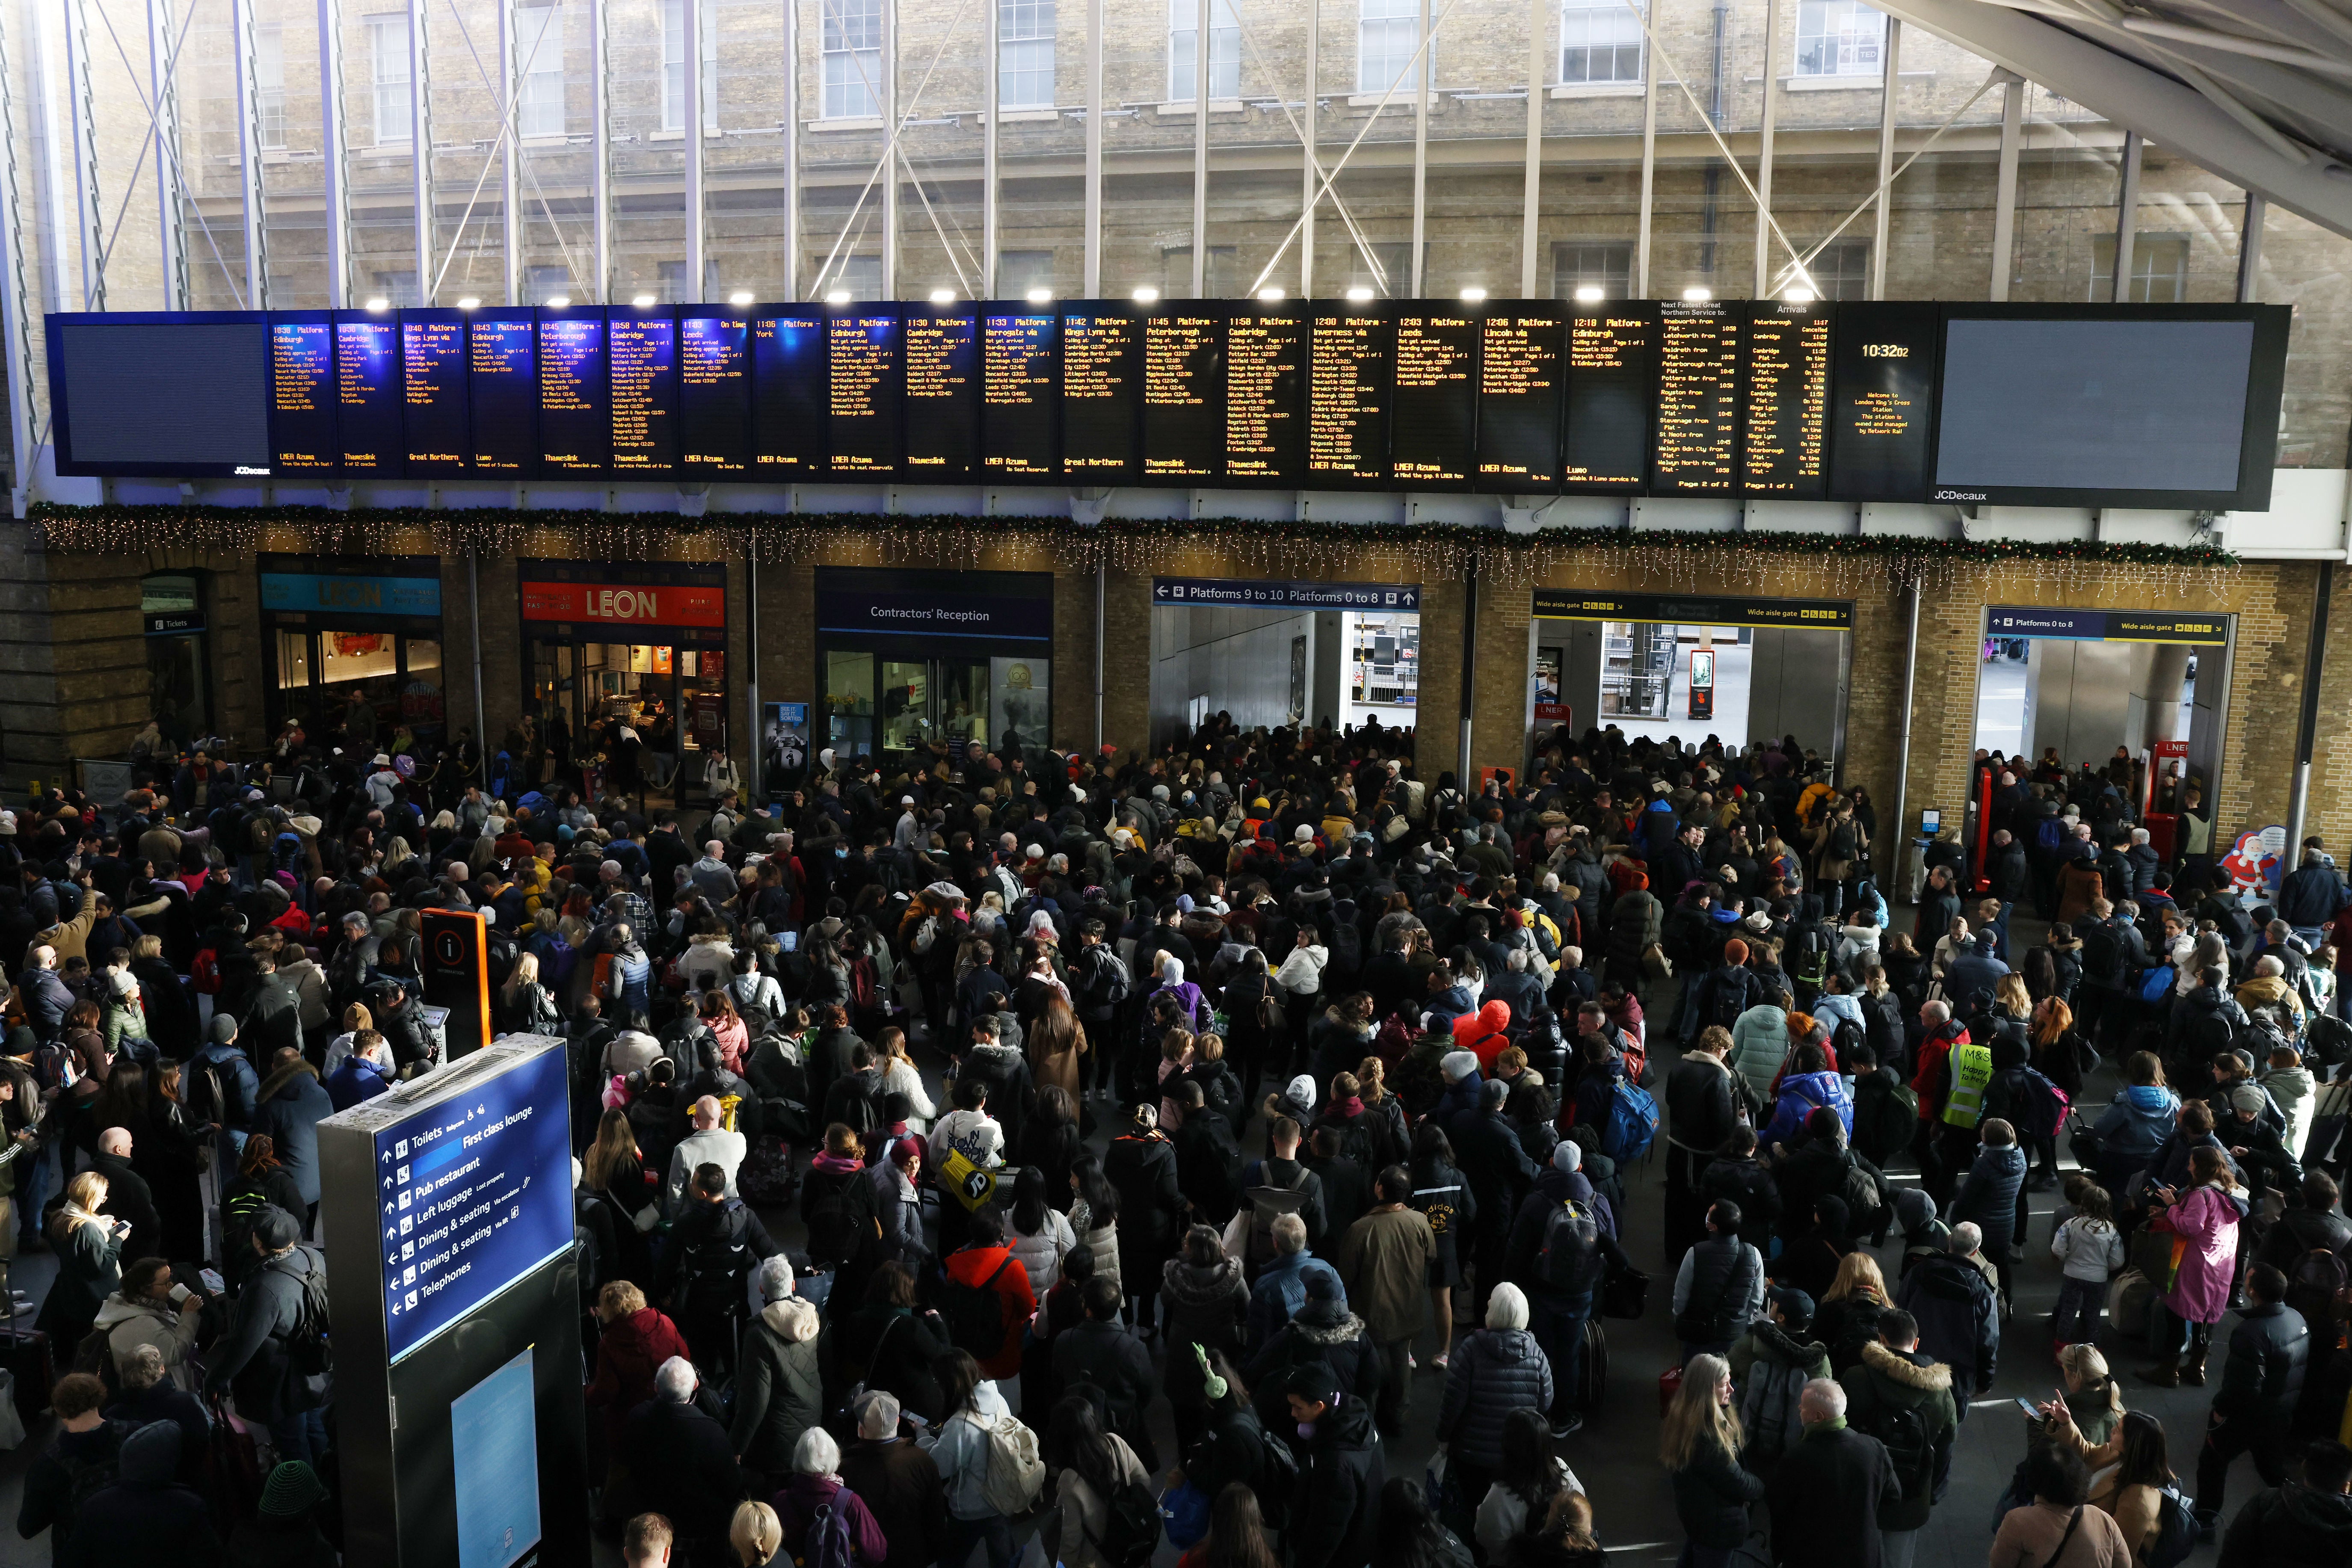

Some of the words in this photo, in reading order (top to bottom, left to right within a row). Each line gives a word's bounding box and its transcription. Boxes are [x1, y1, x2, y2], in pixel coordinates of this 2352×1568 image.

[1777, 304, 1808, 313] Arrivals
[1066, 318, 1086, 326] 11:42
[1230, 317, 1251, 325] 11:58
[1400, 318, 1422, 326] 12:03
[1487, 318, 1509, 326] 12:06
[1575, 319, 1597, 327] 12:18
[542, 323, 560, 331] 10:45
[610, 331, 644, 340] Cambridge
[831, 329, 866, 337] Edinburgh
[907, 329, 943, 337] Cambridge
[986, 328, 1024, 337] Harrogate
[1146, 328, 1200, 337] Peterborough
[1229, 328, 1268, 337] Cambridge
[1314, 328, 1353, 336] Inverness
[1355, 328, 1367, 336] via
[1398, 328, 1422, 337] Leeds
[1485, 328, 1513, 337] Lincoln
[1516, 329, 1528, 337] via
[1573, 329, 1614, 339] Edinburgh
[472, 333, 504, 341] Edinburgh
[1310, 461, 1329, 469] LNER
[1332, 462, 1356, 470] Azuma
[234, 467, 270, 475] JCDecaux
[1934, 490, 1987, 500] JCDecaux
[318, 581, 382, 607] LEON
[1191, 587, 1241, 599] Platforms
[1244, 589, 1251, 599] 9
[1254, 590, 1266, 600] to
[1270, 590, 1283, 600] 10
[1290, 590, 1342, 602] Platforms
[1345, 592, 1353, 602] 0
[1355, 593, 1368, 603] to
[1371, 593, 1378, 603] 8
[586, 590, 656, 618] LEON
[871, 606, 933, 618] Contractors'
[937, 609, 989, 622] Reception
[1965, 1049, 1991, 1062] M&S
[1963, 1065, 1988, 1077] Happy
[1971, 1076, 1986, 1085] Help
[463, 1130, 483, 1149] First
[483, 1121, 504, 1138] class
[505, 1106, 532, 1127] lounge
[412, 1127, 442, 1148] Toilets
[446, 1120, 465, 1133] Babycare
[415, 1181, 434, 1200] Pub
[435, 1157, 480, 1189] restaurant
[971, 1172, 986, 1198] JD
[417, 1206, 436, 1225] Left
[438, 1187, 472, 1213] luggage
[476, 1182, 486, 1192] Lost
[486, 1172, 505, 1187] property
[419, 1226, 448, 1249] Dining
[450, 1219, 458, 1231] &
[459, 1201, 490, 1226] seating
[501, 1187, 520, 1201] escalator
[420, 1250, 450, 1274] Dining
[452, 1243, 459, 1255] &
[461, 1225, 492, 1250] seating
[203, 1269, 214, 1278] Tefal
[421, 1262, 471, 1298] Telephones
